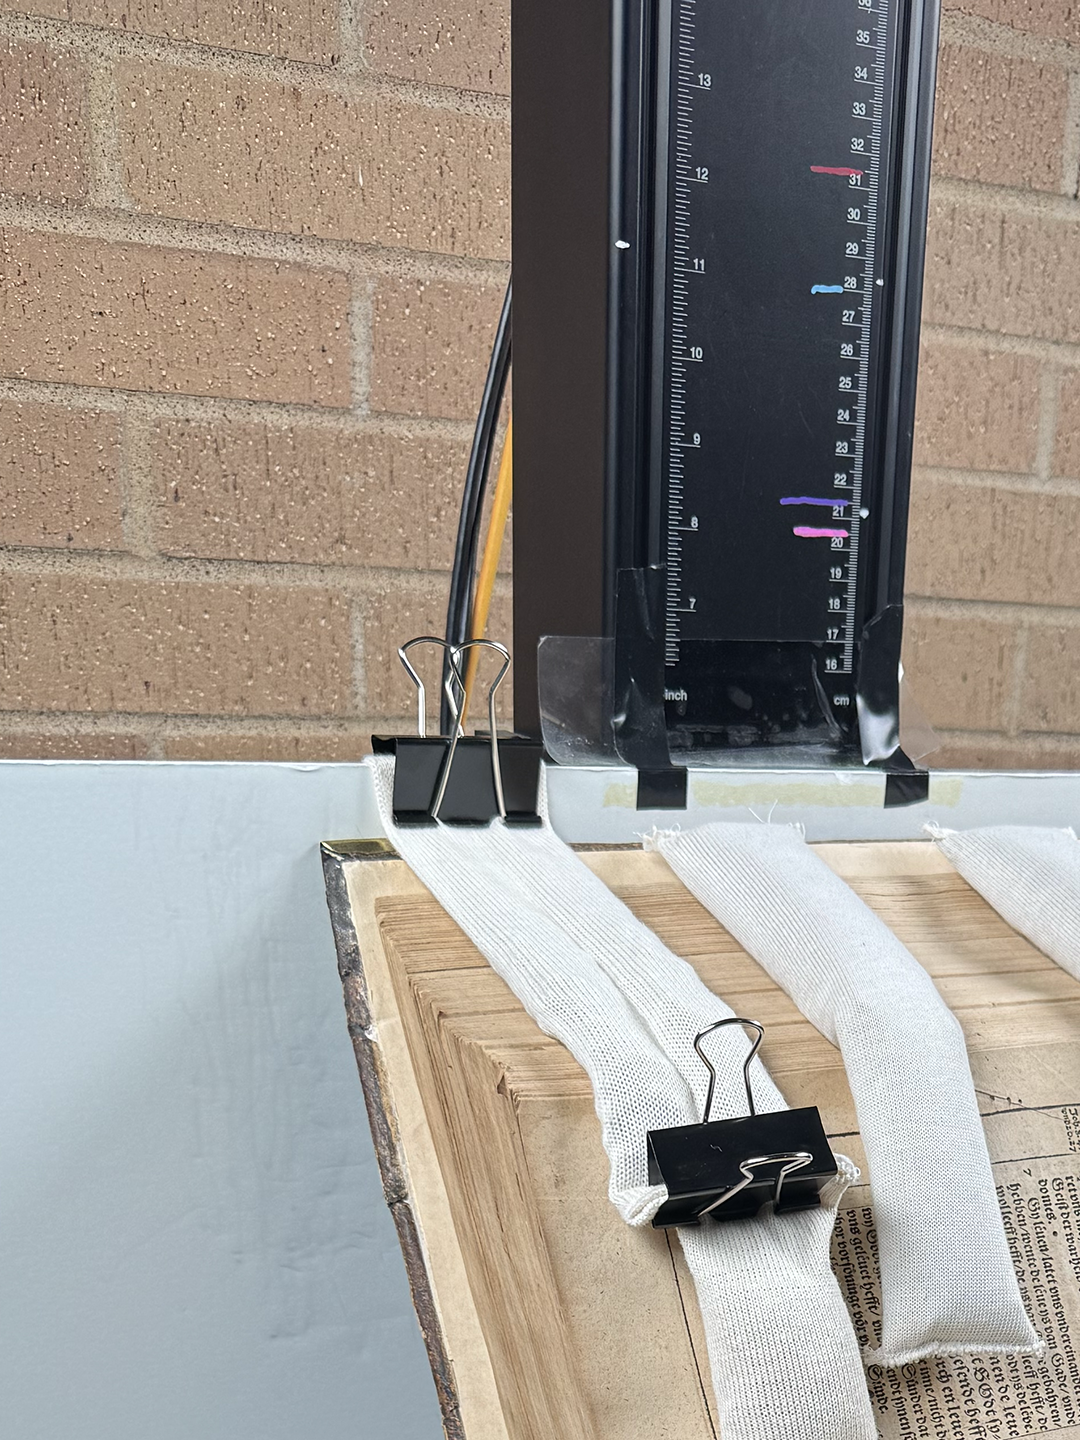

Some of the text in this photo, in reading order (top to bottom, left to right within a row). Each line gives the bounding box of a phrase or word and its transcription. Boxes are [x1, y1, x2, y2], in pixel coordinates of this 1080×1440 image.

[857, 30, 869, 43] 35
[855, 66, 868, 79] 34
[698, 73, 711, 87] 13
[853, 101, 866, 115] 33
[851, 137, 864, 150] 32
[696, 167, 708, 180] 12
[849, 173, 861, 185] 31
[848, 208, 860, 220] 30
[846, 242, 859, 254] 29
[694, 258, 705, 271] 11
[844, 276, 857, 288] 28
[842, 310, 855, 322] 27
[690, 347, 702, 358] 10
[841, 343, 853, 355] 26
[839, 376, 852, 388] 25
[837, 409, 850, 421] 24
[694, 433, 701, 445] 9
[836, 441, 848, 453] 23
[834, 473, 847, 485] 22
[833, 506, 844, 516] 21
[691, 516, 698, 528] 8
[831, 537, 843, 548] 20
[830, 567, 842, 579] 19
[689, 597, 696, 608] 7
[829, 598, 840, 609] 18
[827, 628, 838, 640] 17
[825, 658, 837, 670] 16
[665, 688, 687, 702] inch
[834, 695, 849, 706] cm
[997, 1383, 1010, 1402] de
[915, 1415, 930, 1438] dat
